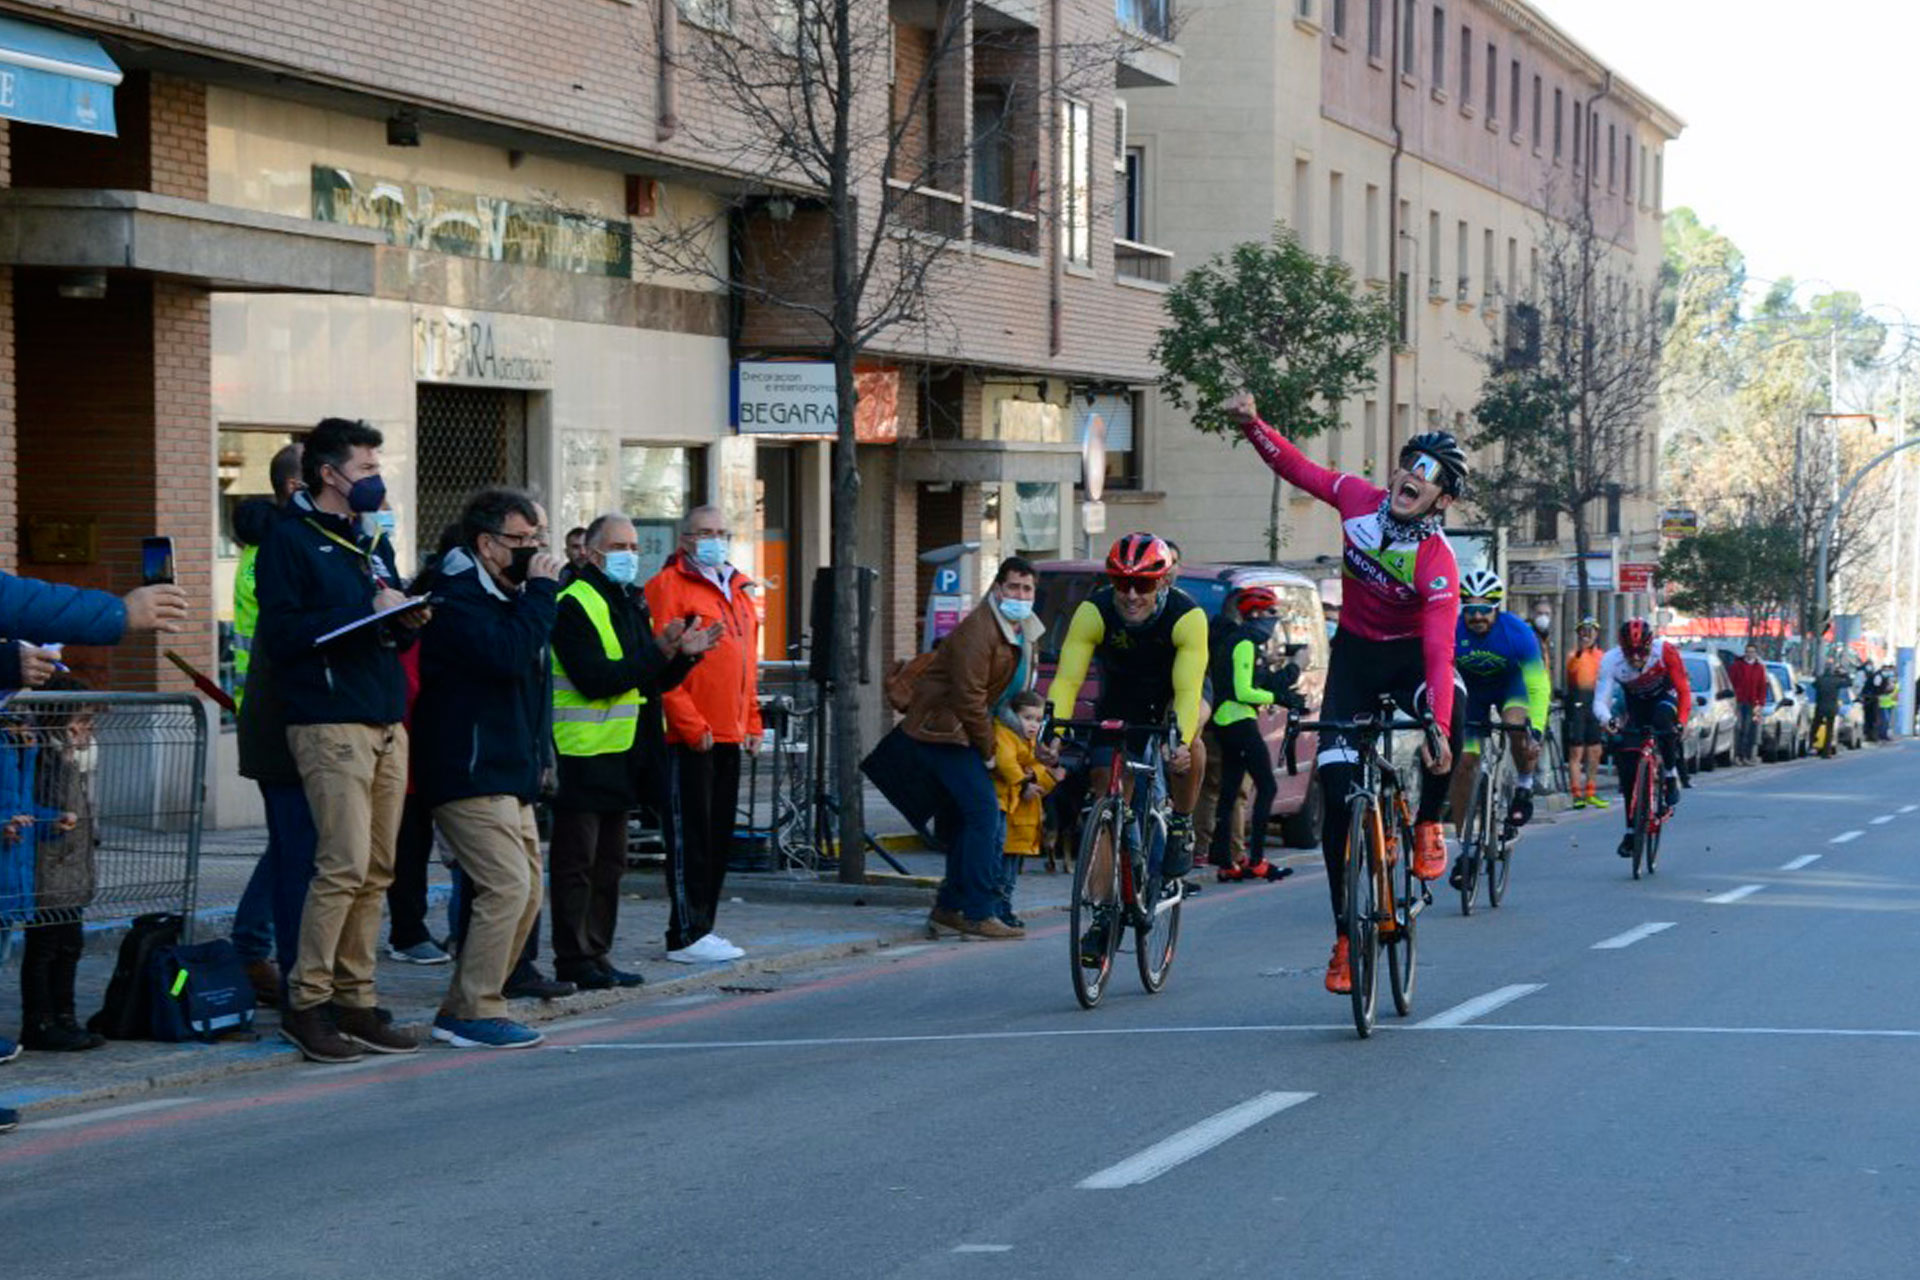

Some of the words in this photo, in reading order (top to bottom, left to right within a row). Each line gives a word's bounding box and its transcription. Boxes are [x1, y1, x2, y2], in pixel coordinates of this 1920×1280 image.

[740, 402, 837, 424] BEGARA
[1346, 549, 1388, 585] ABORAL
[942, 569, 957, 591] P
